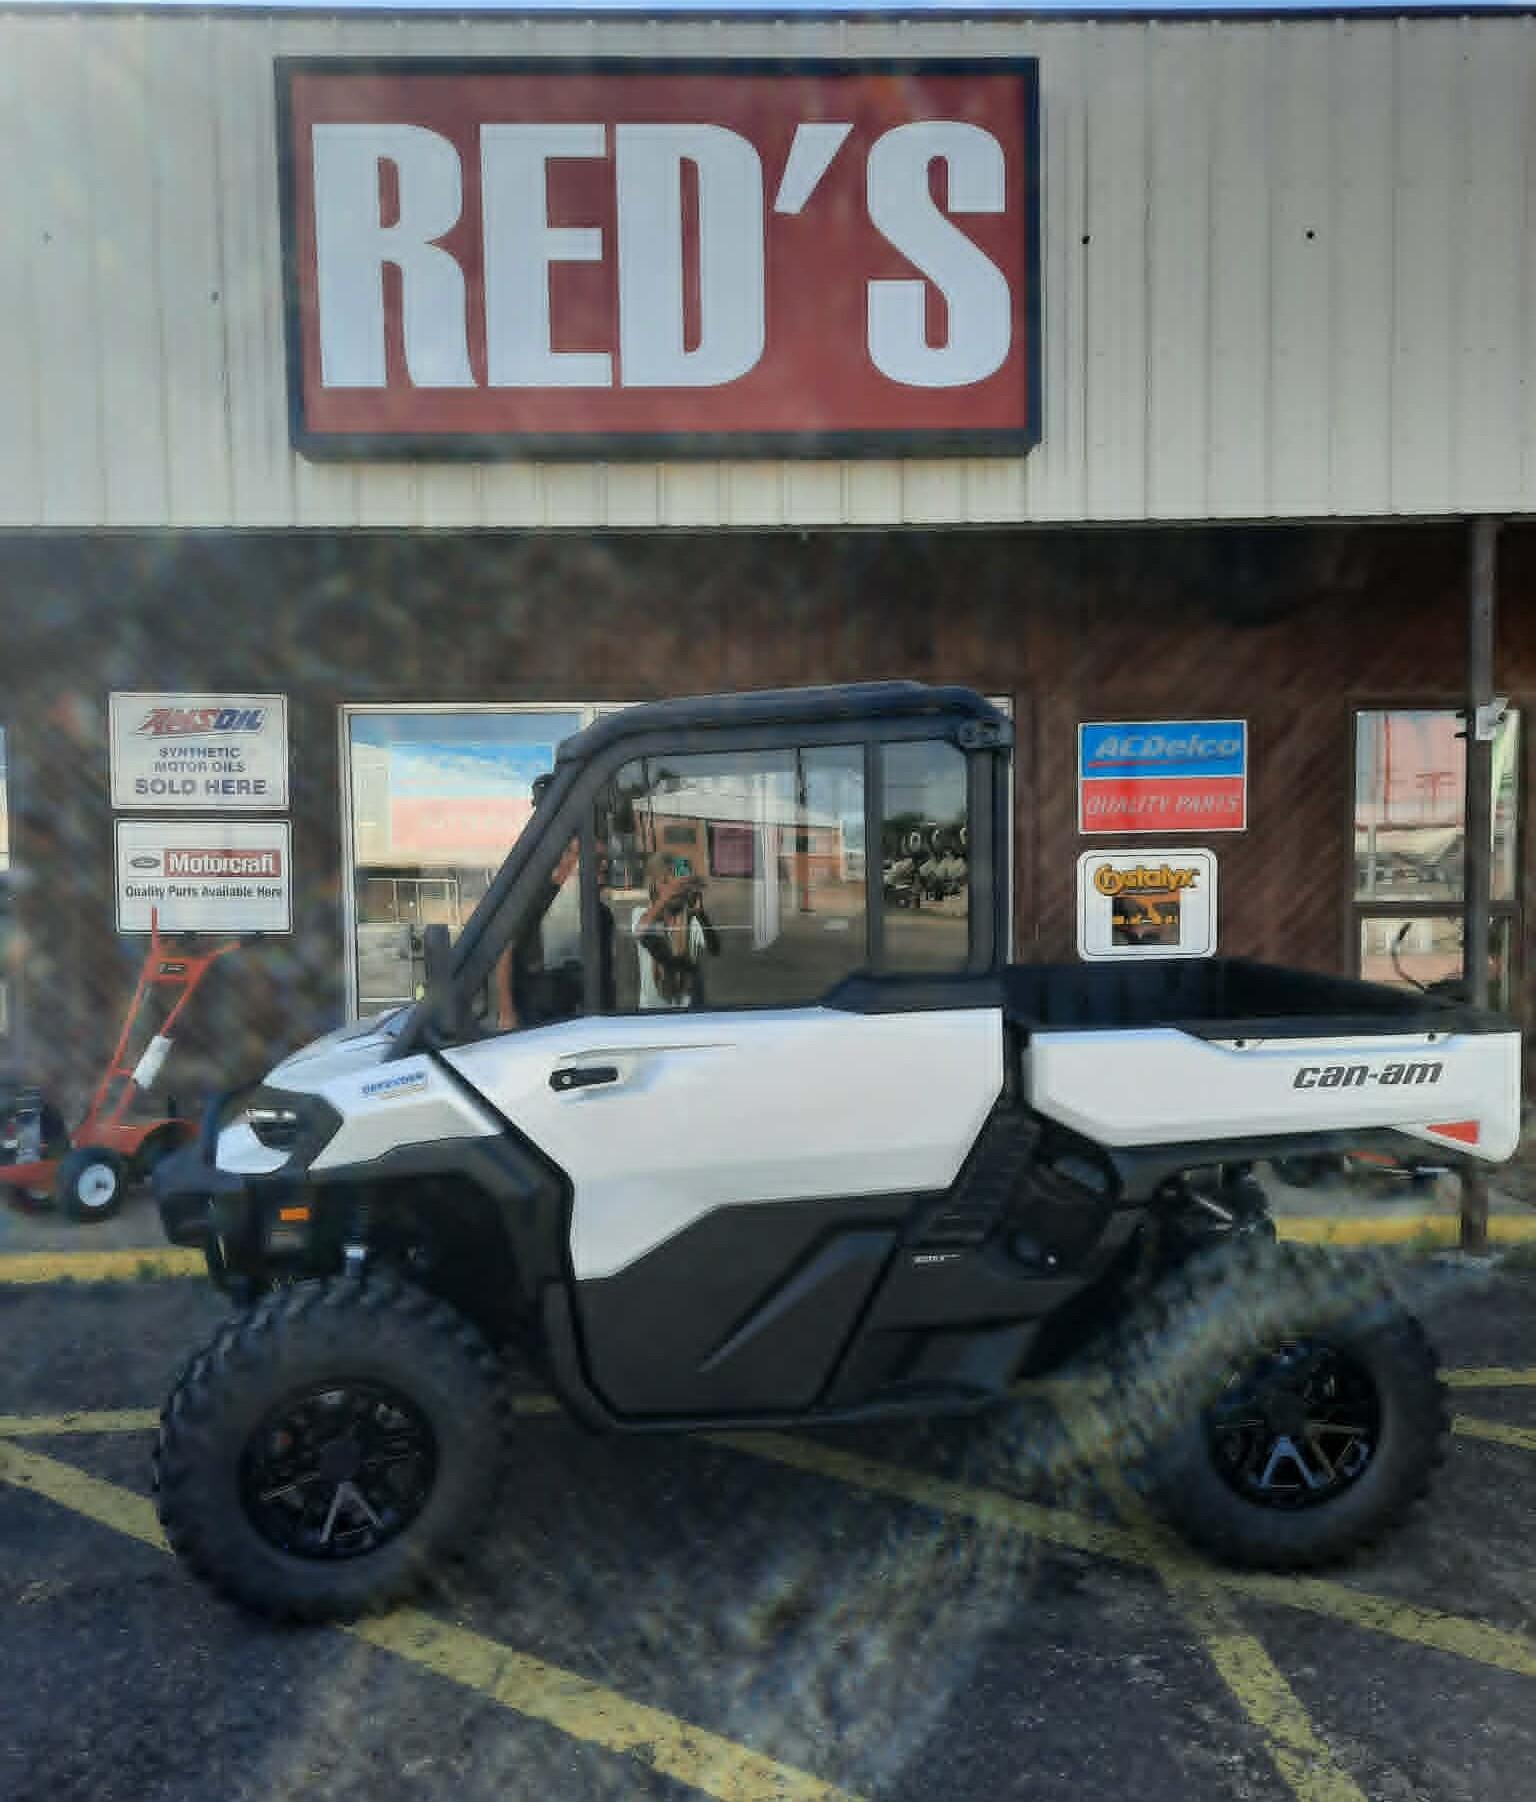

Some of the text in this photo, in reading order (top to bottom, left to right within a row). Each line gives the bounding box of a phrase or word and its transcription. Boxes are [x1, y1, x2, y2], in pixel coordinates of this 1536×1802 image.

[311, 119, 1011, 388] RED'S
[137, 708, 265, 734] AMSOIL
[159, 747, 241, 758] SYNTHETIC
[1095, 734, 1241, 758] ACDelco
[154, 761, 246, 773] MOTOR OILS
[135, 779, 267, 796] SOLD HERE
[1087, 793, 1241, 815] QUALITY PARTS
[168, 852, 273, 874] Motorcraft
[125, 884, 282, 900] Quality Parts Available Here
[1293, 1061, 1443, 1089] can-am
